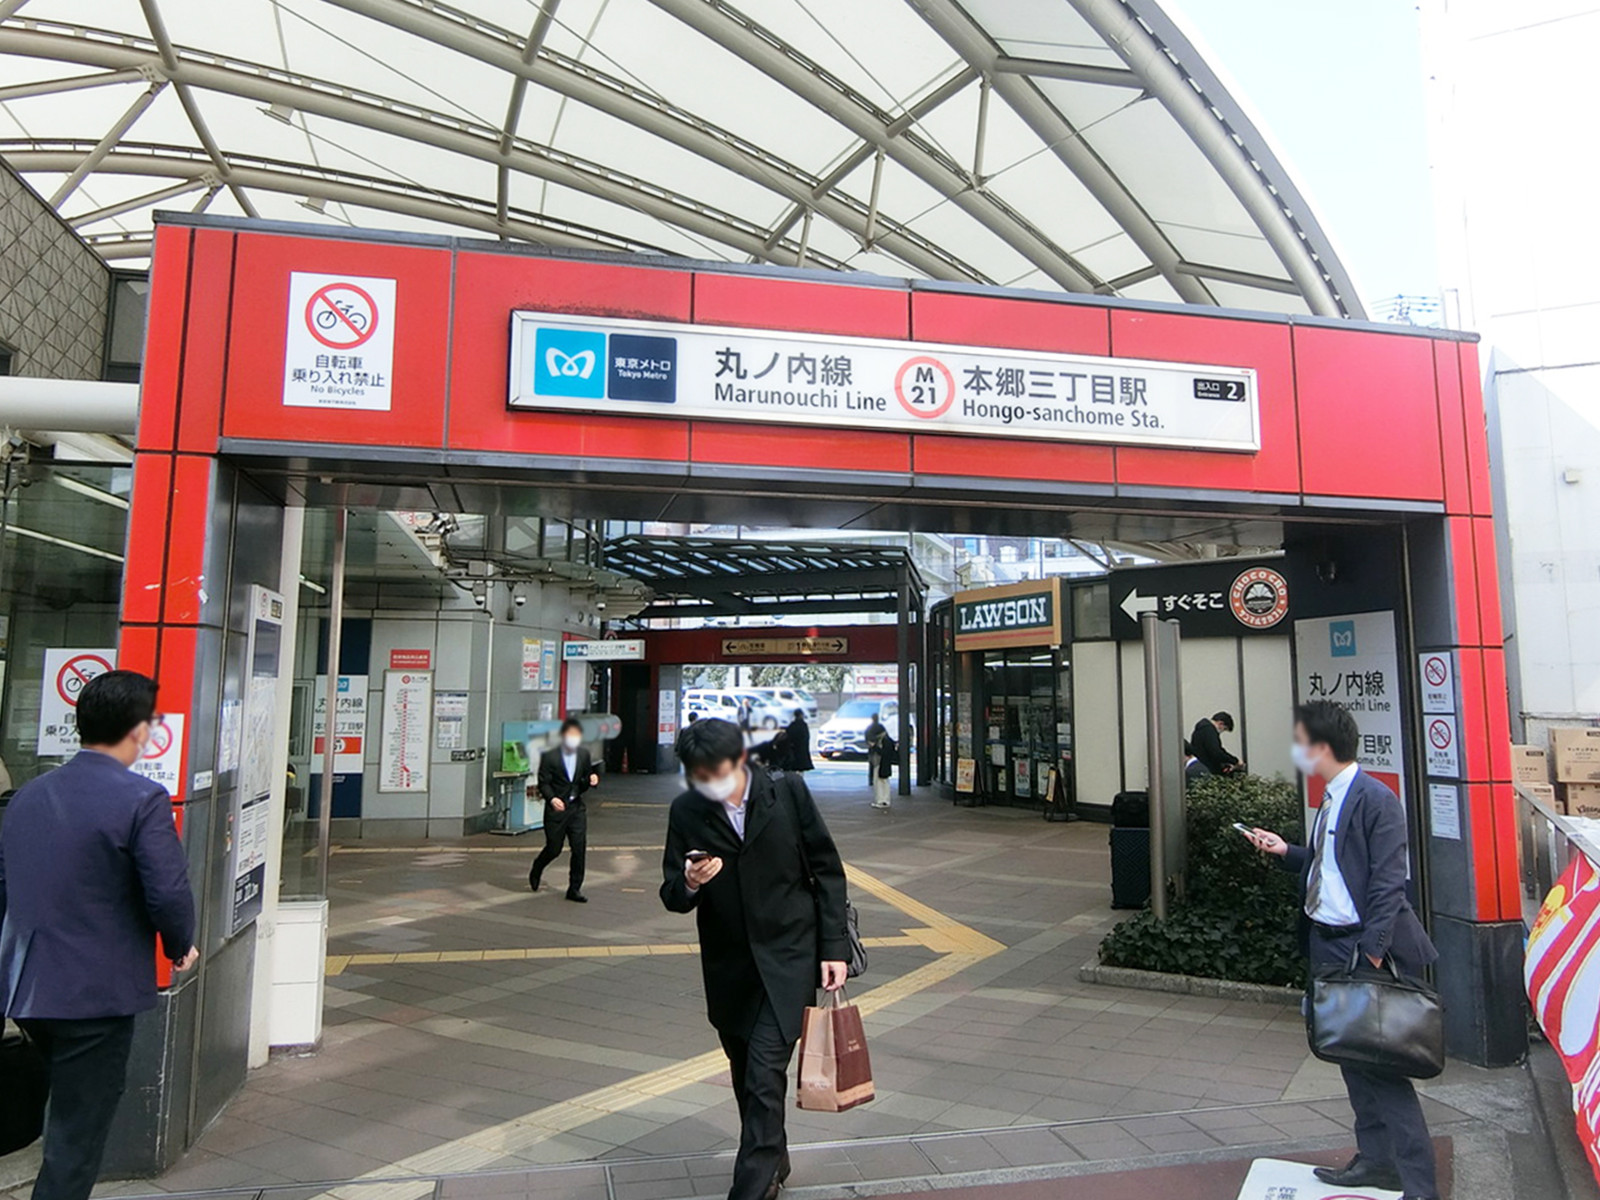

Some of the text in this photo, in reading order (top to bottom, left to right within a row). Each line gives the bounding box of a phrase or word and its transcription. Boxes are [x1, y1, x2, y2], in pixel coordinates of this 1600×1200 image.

[315, 354, 363, 369] 自転車
[614, 357, 671, 371] 東京メトロ
[714, 347, 853, 387] 丸ノ内線
[291, 368, 385, 387] 乗り入れ禁止
[618, 368, 667, 380] Tokyo Metro
[915, 366, 935, 383] M
[310, 385, 365, 396] No Bicycles
[911, 385, 937, 405] 21
[963, 365, 1149, 407] 本郷三丁目駅
[1226, 382, 1239, 399] 2
[714, 383, 887, 411] Marunouchi Line
[963, 399, 1165, 429] Hongo-sanchome Sta.
[1162, 593, 1224, 612] すぐそこ
[960, 597, 1047, 630] LAWSON
[1309, 670, 1385, 697] 丸ノ内線
[1368, 699, 1391, 712] Line
